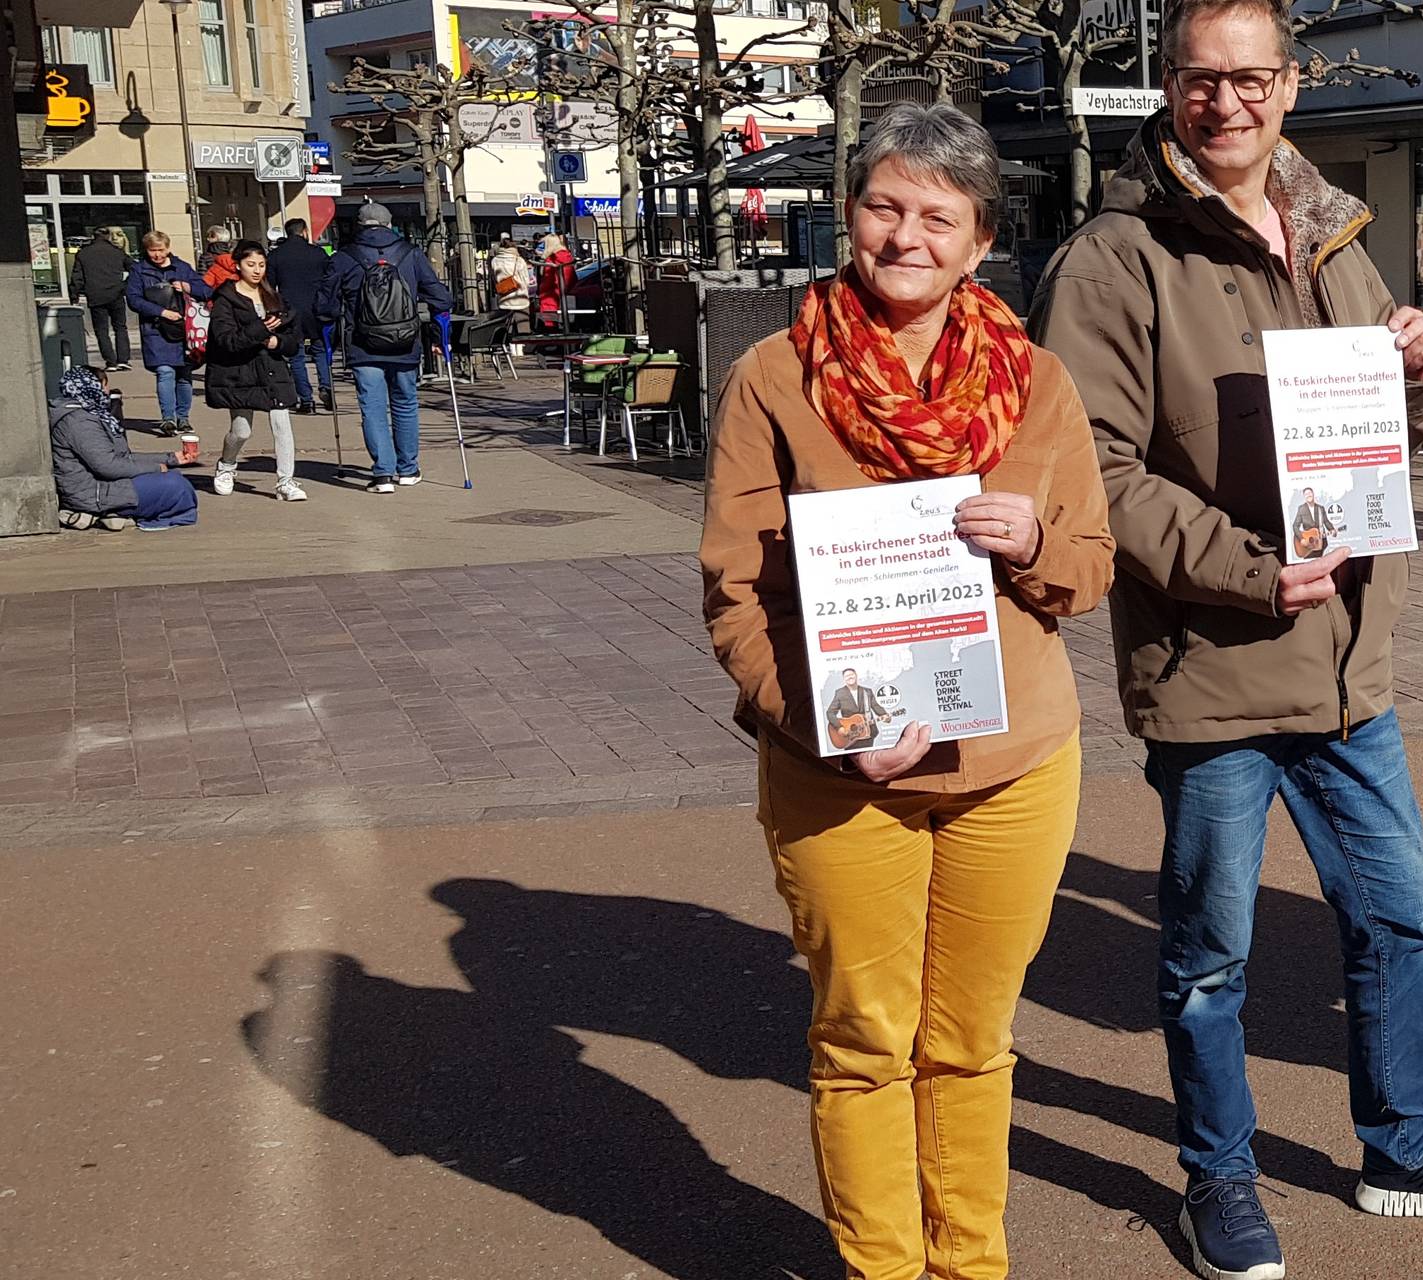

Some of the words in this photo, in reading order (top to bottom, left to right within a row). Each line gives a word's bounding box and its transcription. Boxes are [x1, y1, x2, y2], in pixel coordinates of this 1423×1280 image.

[1085, 92, 1168, 112] Weybachstraß
[522, 195, 543, 208] dm
[1277, 377, 1292, 387] 16.
[1294, 374, 1356, 387] Euskirchener
[1358, 371, 1398, 383] Stadtfest
[1299, 390, 1309, 399] in
[1311, 389, 1327, 399] der
[1329, 386, 1380, 398] Innenstadt
[1283, 427, 1303, 440] 22.
[1305, 426, 1314, 438] &
[1317, 425, 1338, 438] 23.
[1341, 421, 1370, 439] April
[1373, 420, 1401, 434] 2023
[808, 546, 829, 557] 16.
[831, 535, 916, 555] Euskirchener
[839, 558, 852, 569] in
[854, 555, 877, 567] der
[879, 547, 951, 565] Innenstadt
[923, 564, 960, 576] Genießen
[815, 601, 843, 617] 22.
[845, 598, 859, 613] &
[863, 595, 891, 612] 23.
[895, 588, 937, 610] April
[940, 583, 985, 602] 2023
[934, 669, 963, 679] STREET
[935, 678, 957, 687] FOOD
[936, 686, 961, 696] DRINK
[937, 694, 961, 702] MUSIC
[938, 701, 973, 712] FESTIVAL
